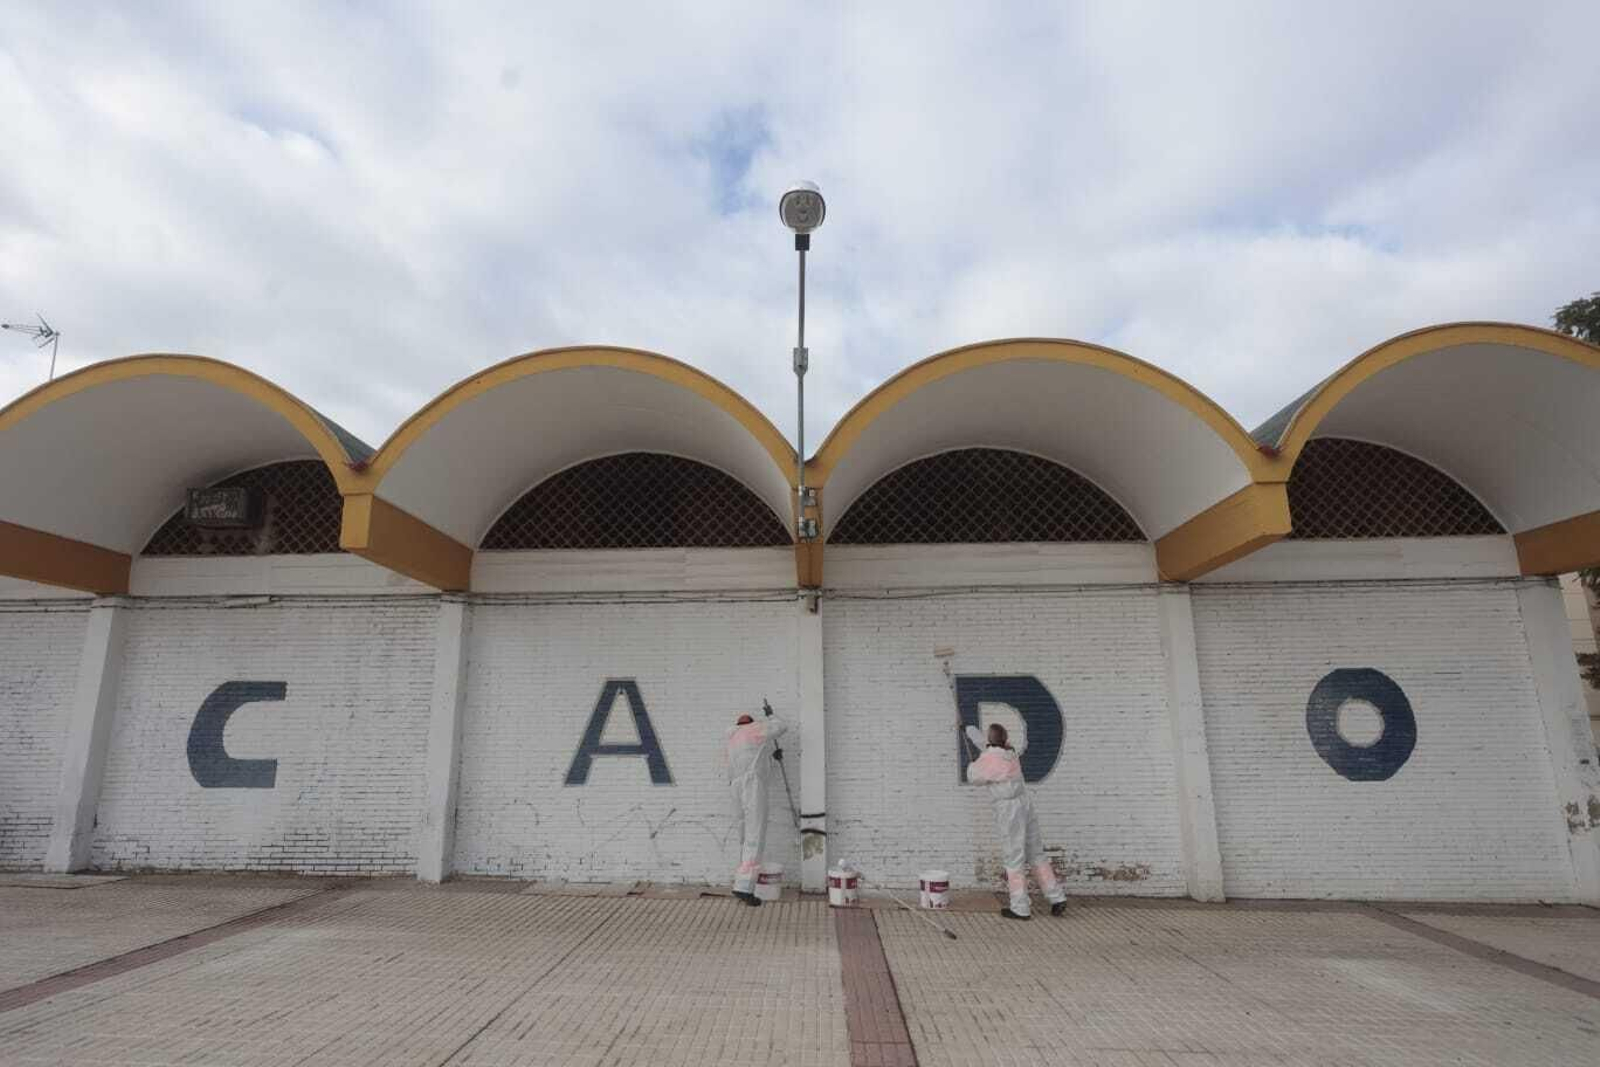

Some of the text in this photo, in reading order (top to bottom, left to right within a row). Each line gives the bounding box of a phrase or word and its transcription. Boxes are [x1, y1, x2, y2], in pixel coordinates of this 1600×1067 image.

[187, 668, 1417, 788] C A D O
